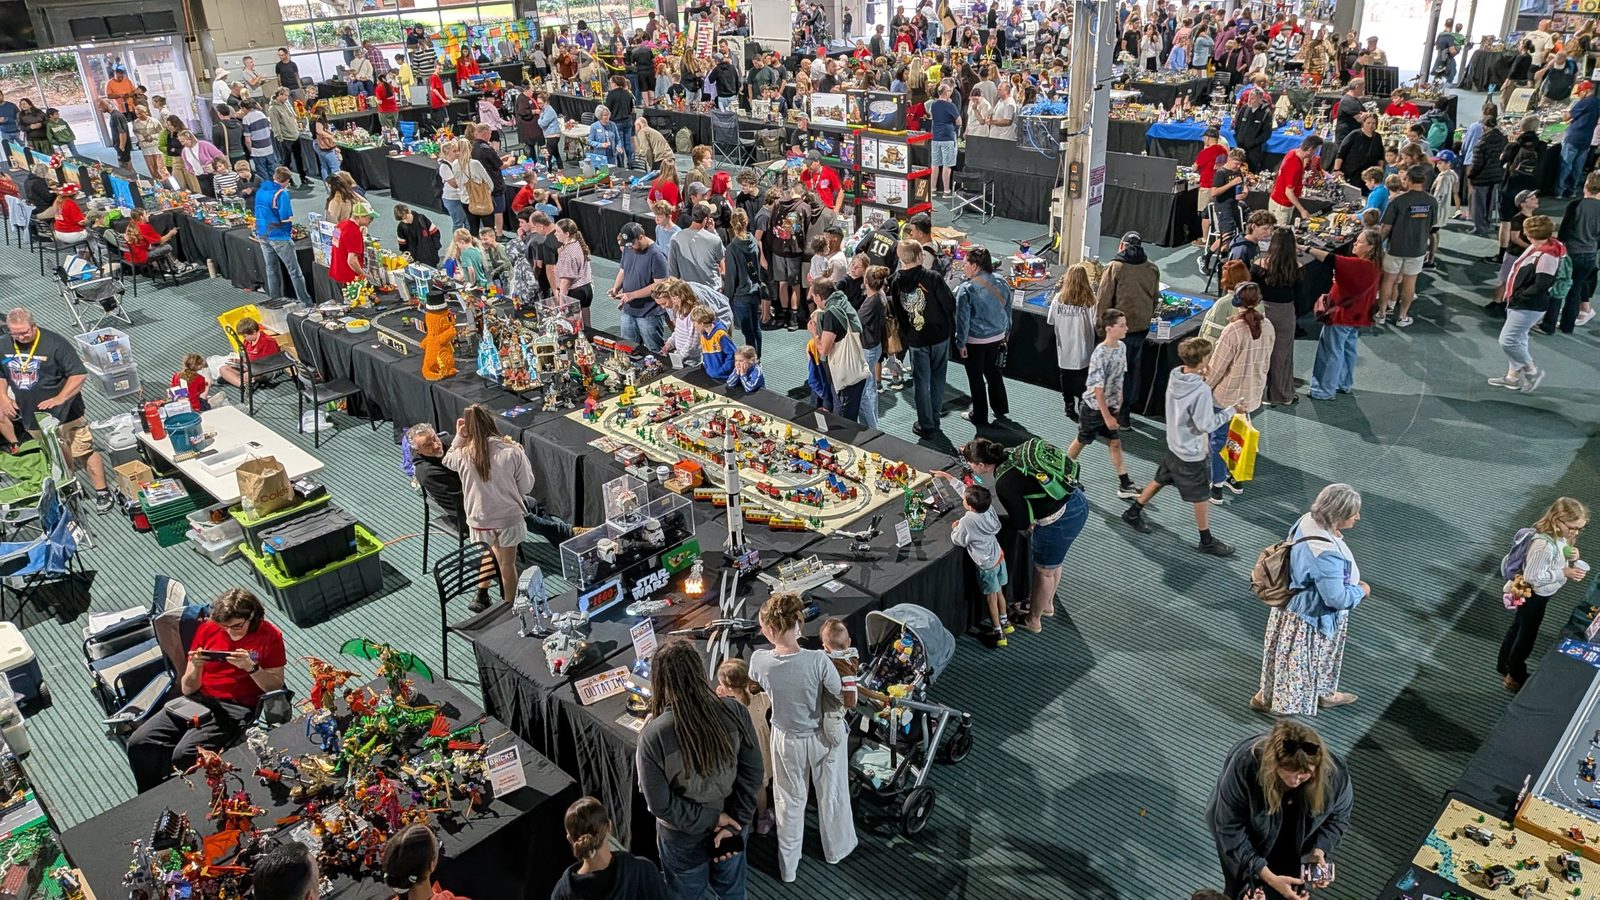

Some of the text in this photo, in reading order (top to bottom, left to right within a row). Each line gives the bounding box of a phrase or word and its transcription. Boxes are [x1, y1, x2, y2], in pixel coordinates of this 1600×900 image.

[873, 232, 894, 246] MESSI
[870, 240, 890, 257] 10
[632, 568, 670, 592] STAR
[632, 576, 670, 600] WARS
[592, 588, 613, 606] LEGO
[489, 751, 514, 766] BRICKS
